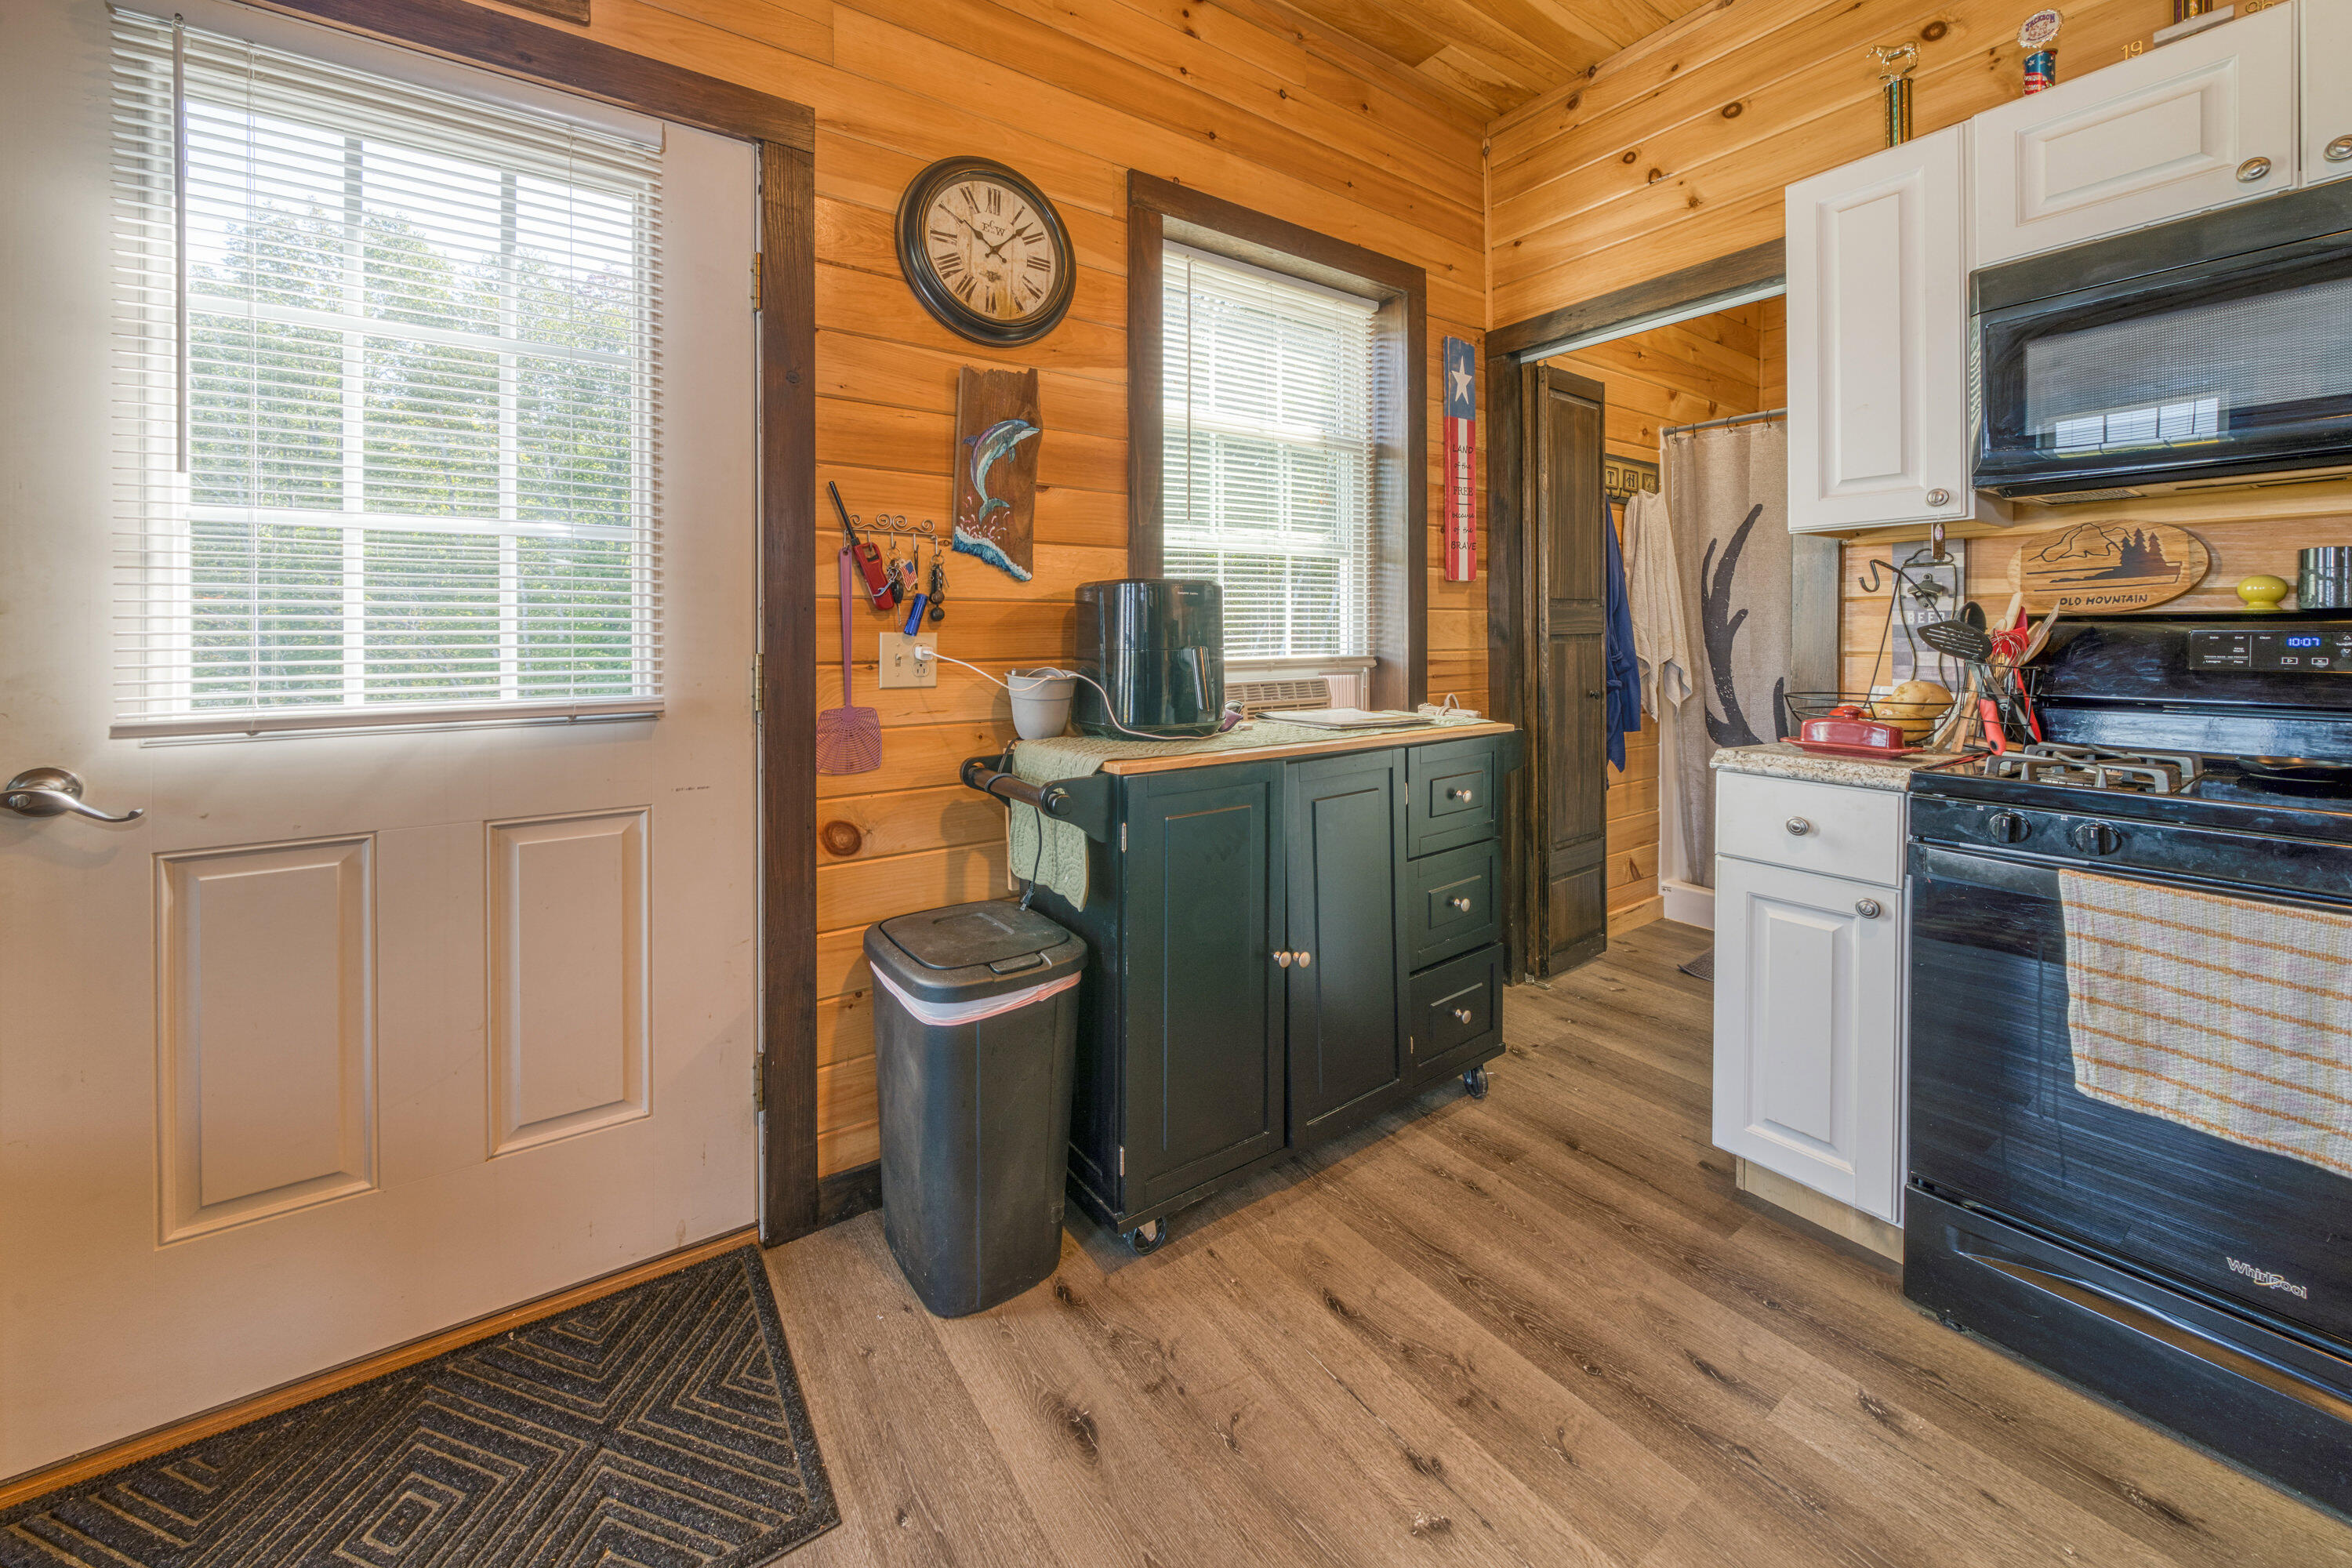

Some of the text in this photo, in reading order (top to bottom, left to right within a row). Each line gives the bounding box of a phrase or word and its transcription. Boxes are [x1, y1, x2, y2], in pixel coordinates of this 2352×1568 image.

[1452, 444, 1474, 454] LAND
[1454, 462, 1461, 470] of
[1453, 486, 1474, 496] FREE
[1450, 540, 1476, 550] BRAVE
[2060, 594, 2147, 606] OLD MOUNTAIN
[2288, 637, 2320, 647] 10:07
[2226, 1257, 2307, 1299] Whirlpool
